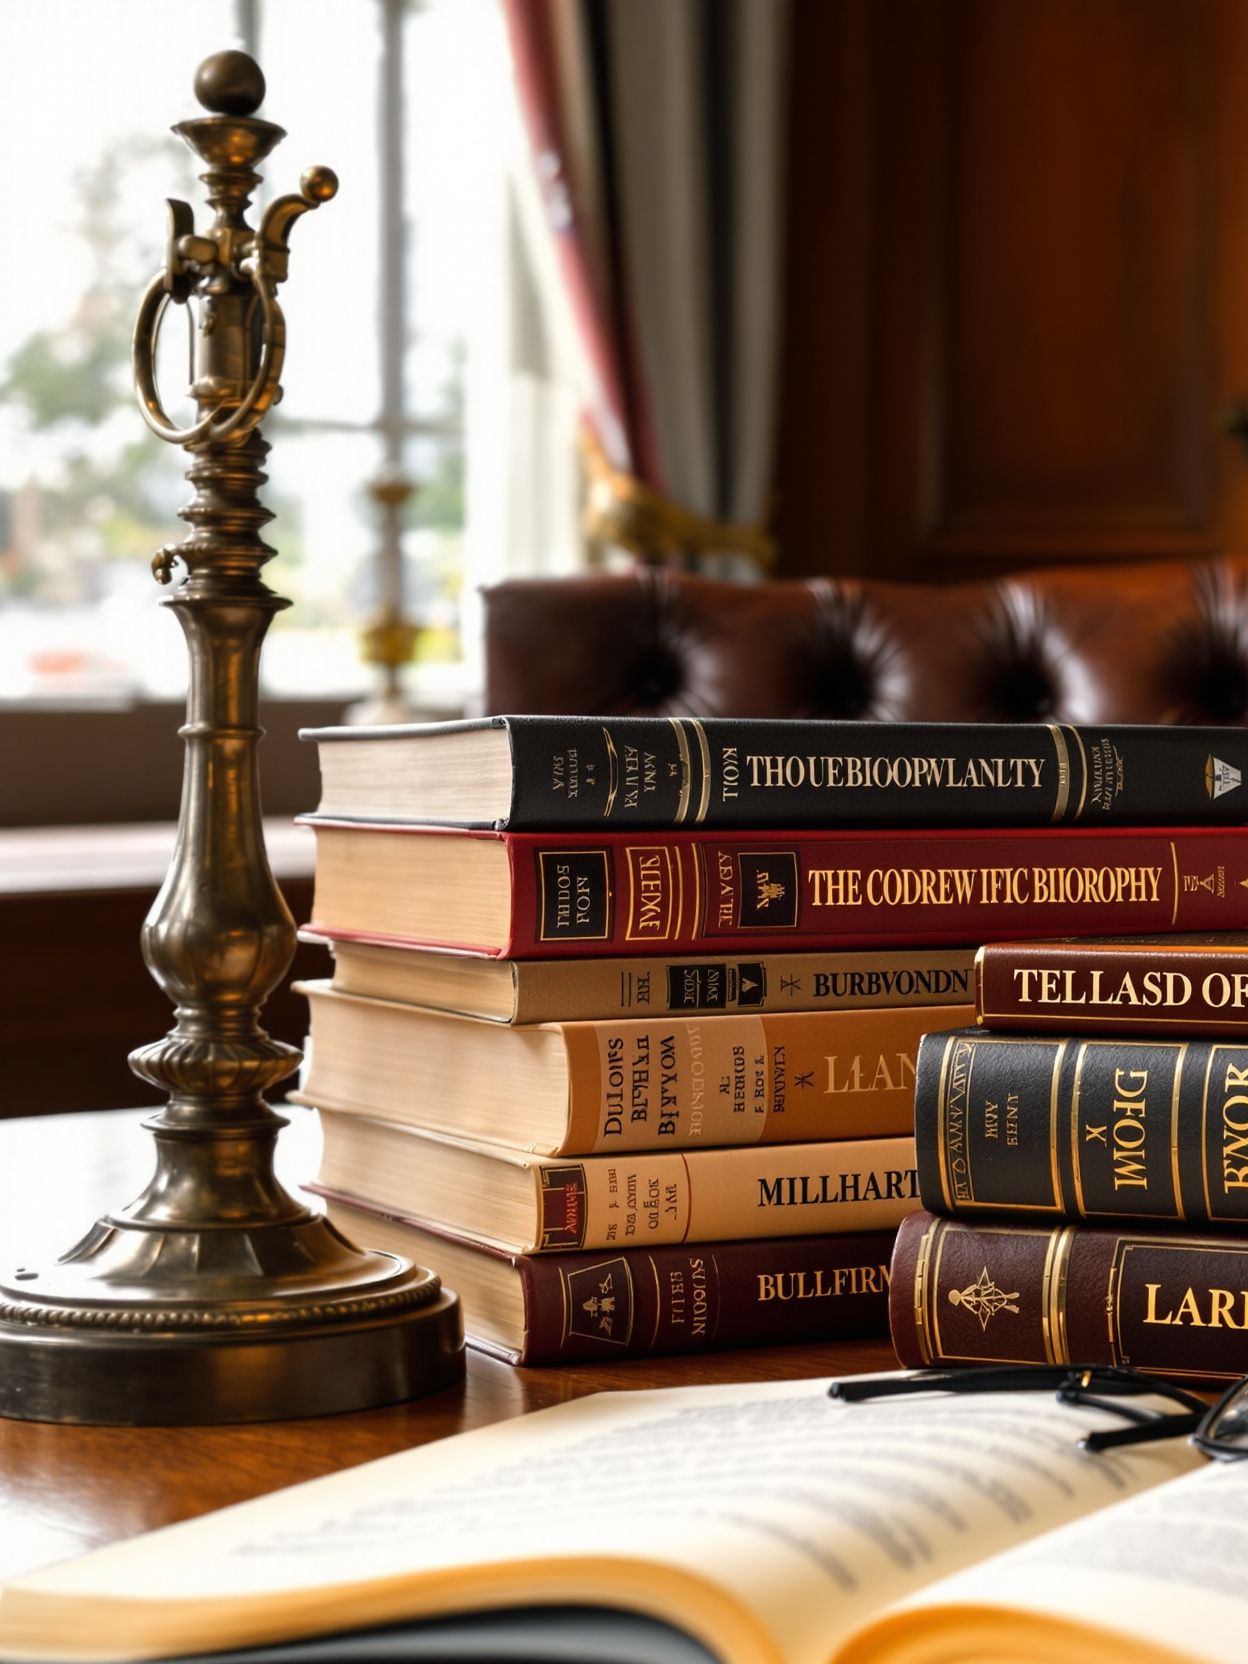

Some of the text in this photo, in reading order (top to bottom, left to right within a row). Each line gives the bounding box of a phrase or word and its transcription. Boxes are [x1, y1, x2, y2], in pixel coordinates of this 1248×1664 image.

[808, 869, 863, 906] THE
[866, 868, 977, 906] CODREW
[1013, 969, 1192, 1006] TELLASD
